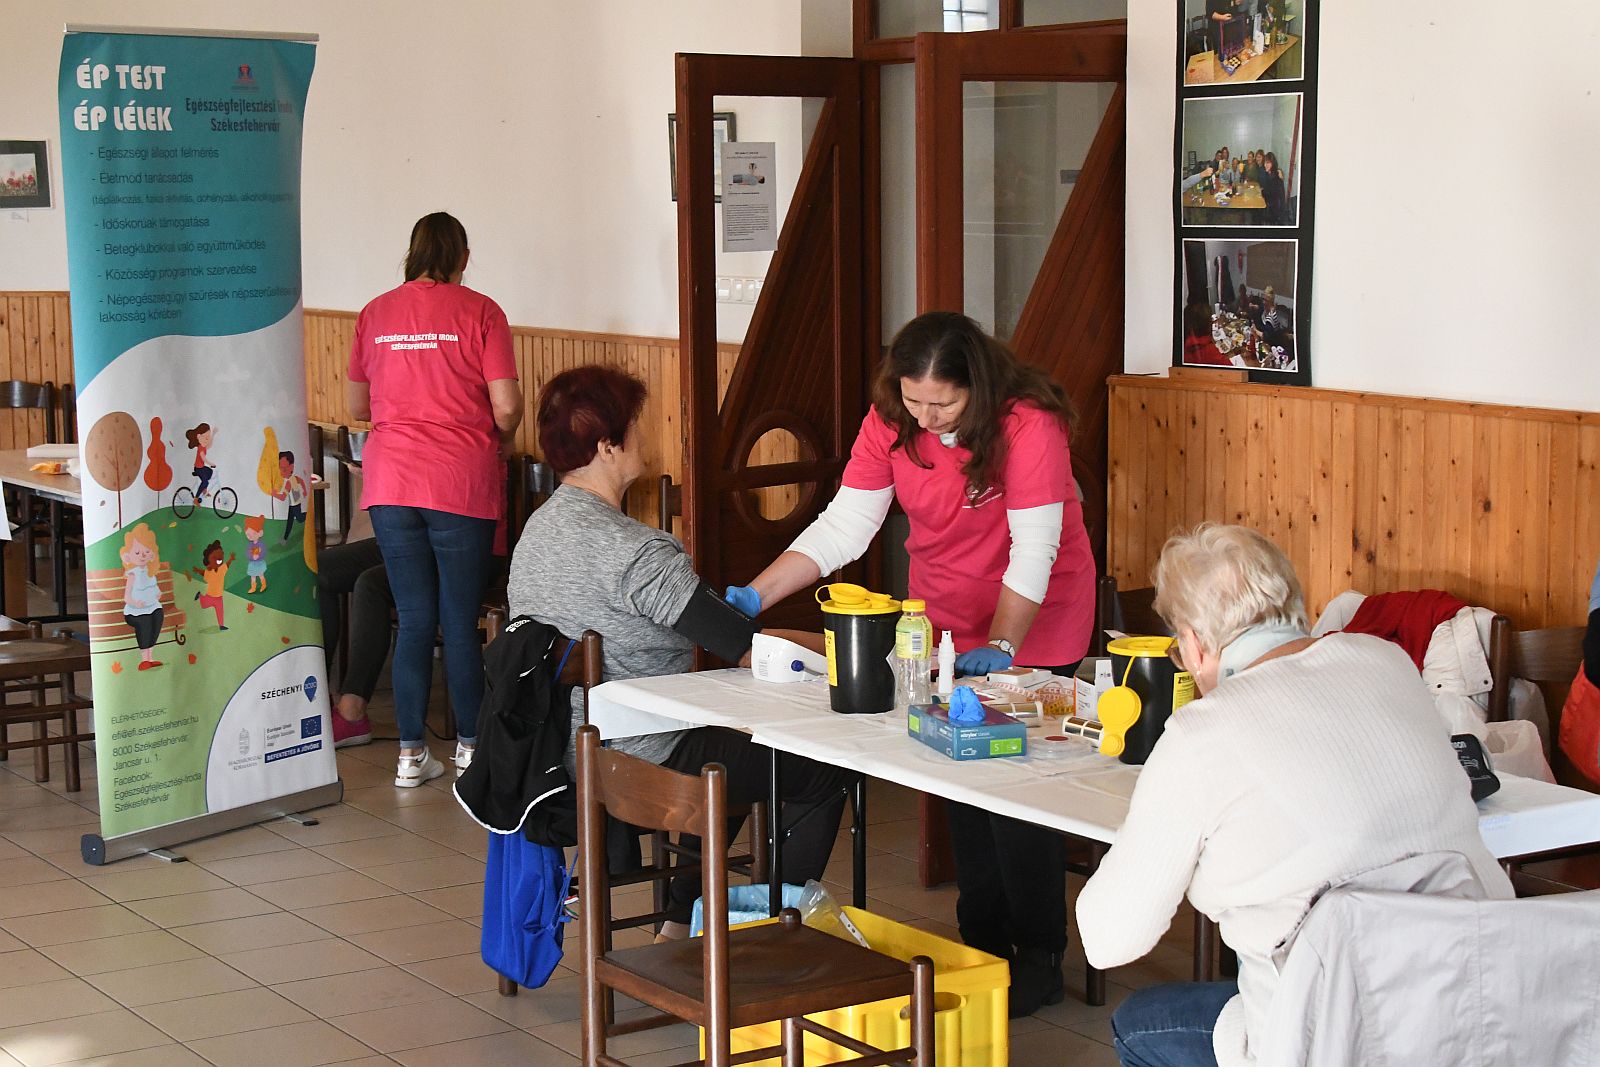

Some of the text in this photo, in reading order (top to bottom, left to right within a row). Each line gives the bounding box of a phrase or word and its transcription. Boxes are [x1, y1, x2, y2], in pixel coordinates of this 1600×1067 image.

[76, 57, 166, 90] ÉP TEST
[73, 100, 173, 131] ÉP LÉLEK
[206, 263, 257, 277] szervezése
[99, 310, 146, 324] lakosság
[438, 333, 459, 342] IRODA
[261, 683, 303, 700] SZÉCHENYI
[112, 744, 133, 757] 8000
[994, 744, 1000, 752] S
[144, 757, 152, 765] u.
[155, 753, 162, 763] 1.
[113, 771, 153, 788] Facebook:
